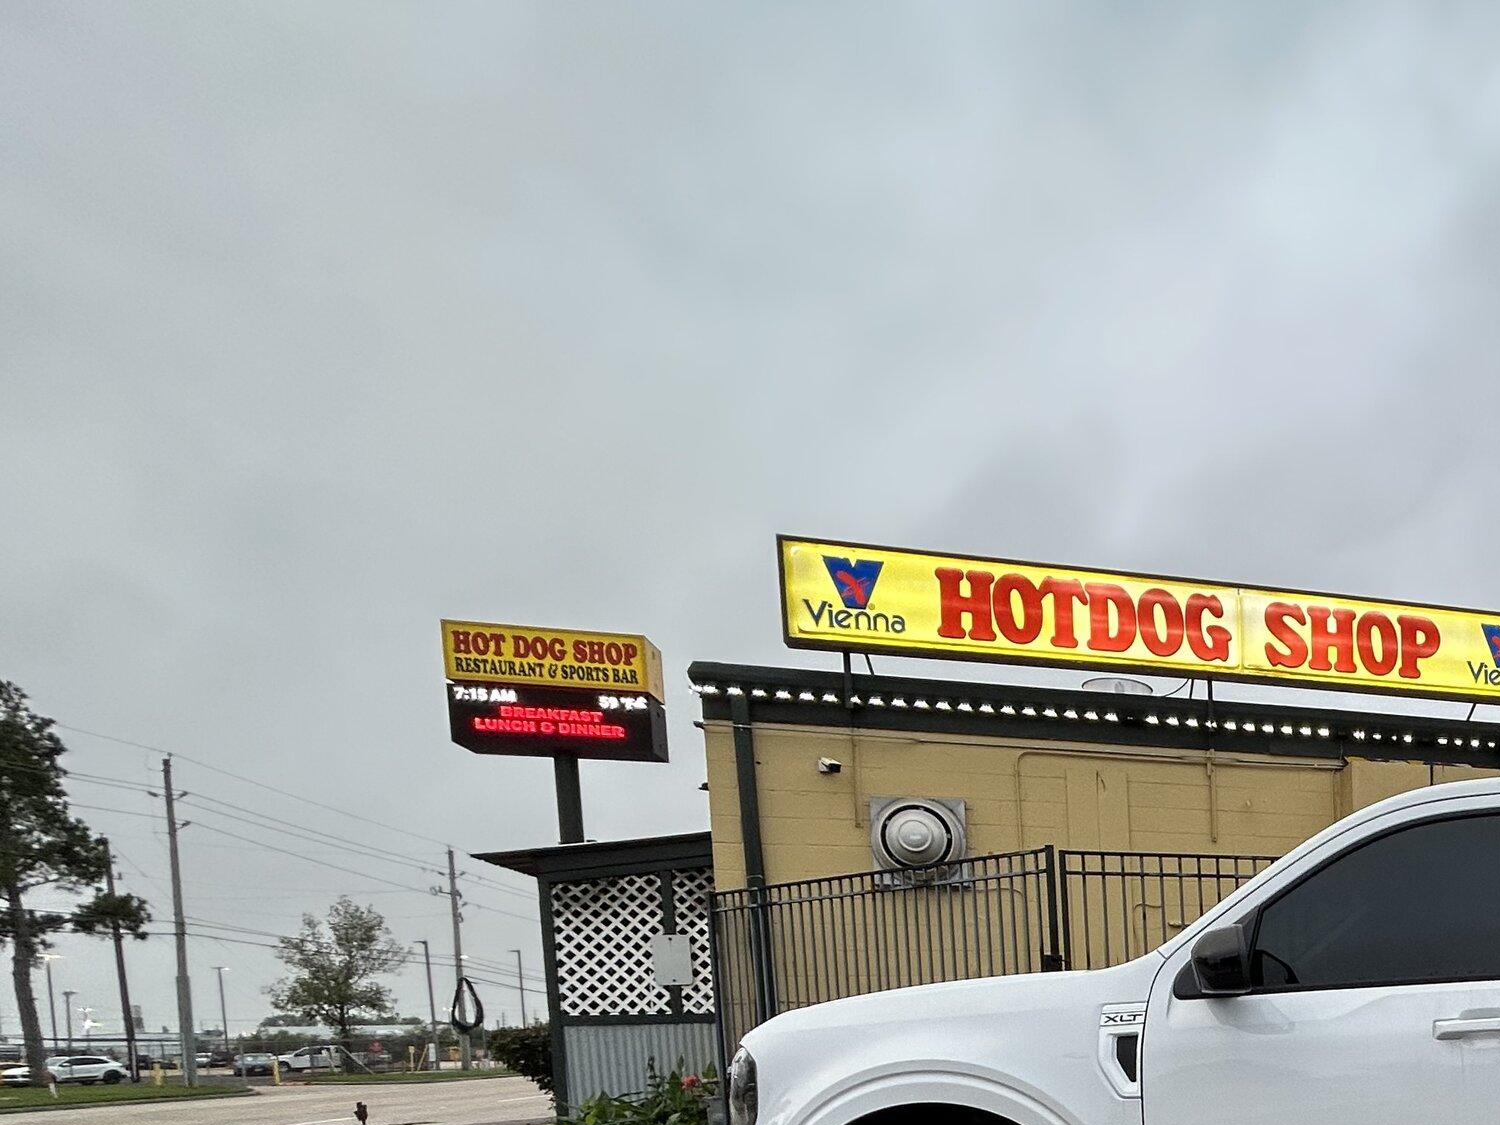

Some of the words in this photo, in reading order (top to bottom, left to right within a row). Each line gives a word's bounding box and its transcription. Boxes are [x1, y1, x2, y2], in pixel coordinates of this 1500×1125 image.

[802, 598, 906, 634] Vienna
[934, 567, 1232, 662] HOTDOG
[1264, 602, 1441, 678] SHOP
[451, 630, 506, 657] HOT
[511, 635, 567, 661] DOG
[573, 640, 638, 667] SHOP
[454, 656, 545, 678] RESTAURANT
[548, 662, 558, 679] &
[561, 664, 609, 683] SPORTS
[612, 667, 639, 685] BAR
[489, 688, 518, 703] AM
[500, 705, 604, 722] BREAKFAST
[474, 717, 537, 733] LUNCH
[540, 721, 556, 734] &
[558, 723, 625, 738] DINNER
[1104, 1014, 1143, 1024] XLT
